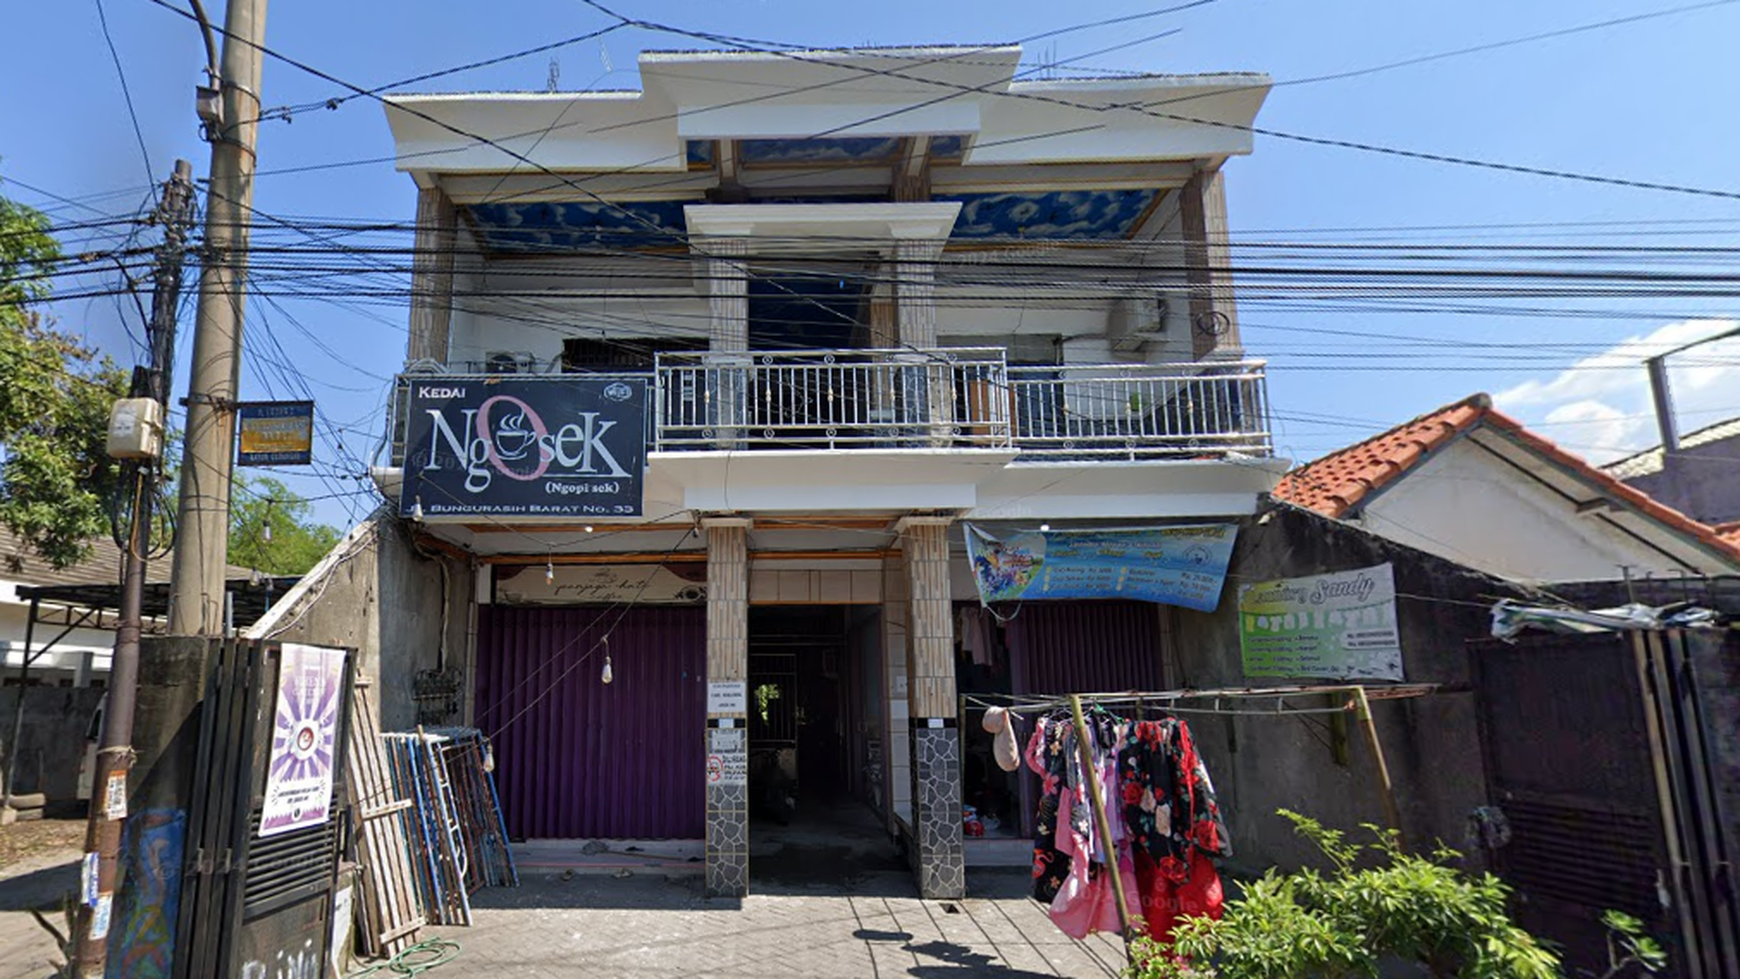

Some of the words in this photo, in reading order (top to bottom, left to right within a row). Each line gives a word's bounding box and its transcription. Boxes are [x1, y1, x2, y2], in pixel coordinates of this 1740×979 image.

[545, 482, 589, 494] (Ngopi
[592, 482, 619, 494] sek)
[529, 504, 579, 513] BARAT
[1309, 573, 1376, 605] Sandy
